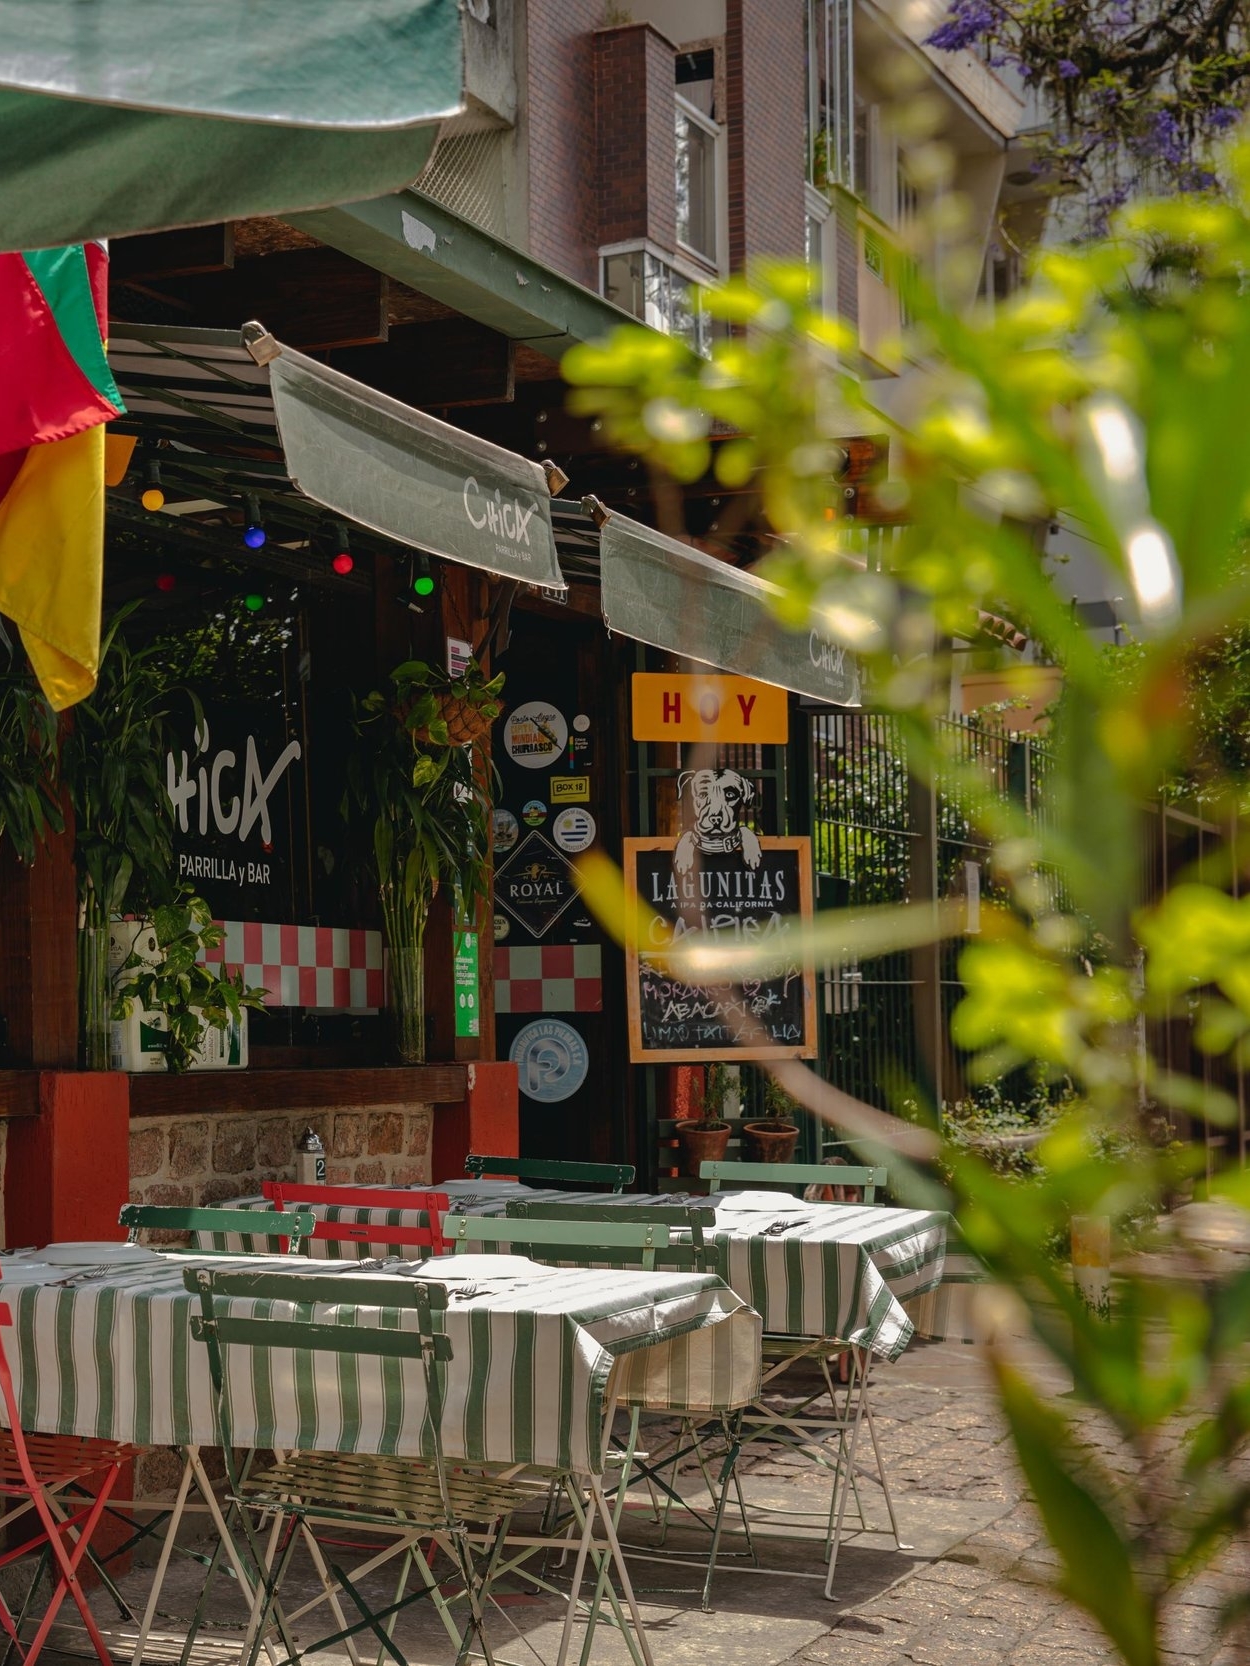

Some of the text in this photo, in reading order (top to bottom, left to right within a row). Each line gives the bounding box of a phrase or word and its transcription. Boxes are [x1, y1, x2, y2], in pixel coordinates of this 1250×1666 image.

[556, 782, 583, 792] BOX 18
[180, 854, 270, 887] PARRILLA y BAR
[510, 882, 564, 898] ROYAL
[652, 869, 786, 902] LAGUNITAS
[716, 901, 774, 909] CALIFORNIA
[538, 1023, 553, 1034] LAS
